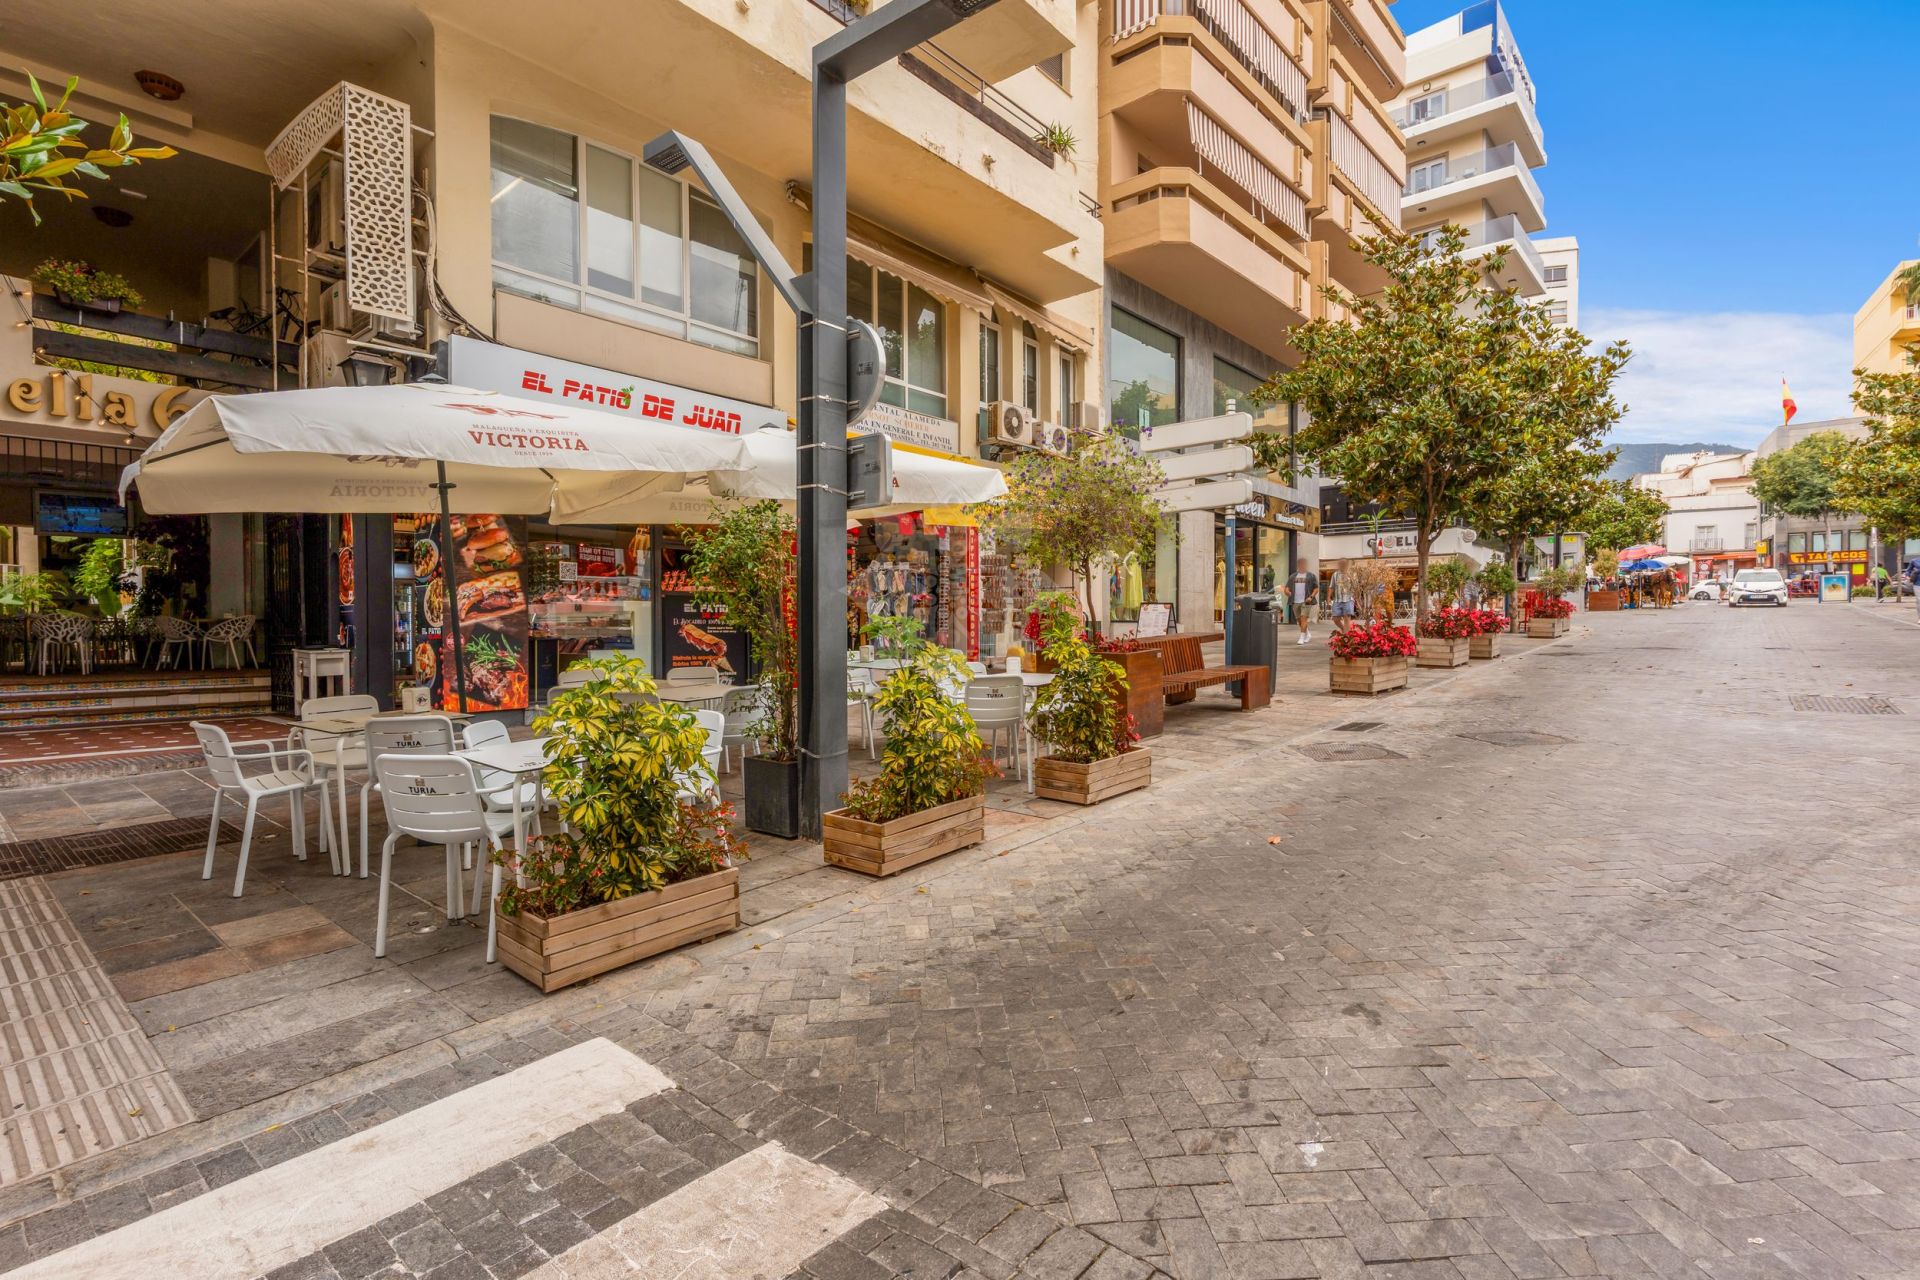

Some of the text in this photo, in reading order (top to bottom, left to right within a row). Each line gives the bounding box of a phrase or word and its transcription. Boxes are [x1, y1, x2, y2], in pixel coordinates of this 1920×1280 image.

[522, 370, 742, 435] EL PATIO DE JUAN
[904, 411, 942, 427] ALAMEDA
[468, 430, 590, 451] VICTORIA
[535, 429, 580, 437] EXQUISITA
[871, 420, 881, 429] EN
[883, 423, 915, 437] GENERAL
[922, 432, 953, 446] INFANTIL
[408, 786, 437, 794] TURIA
